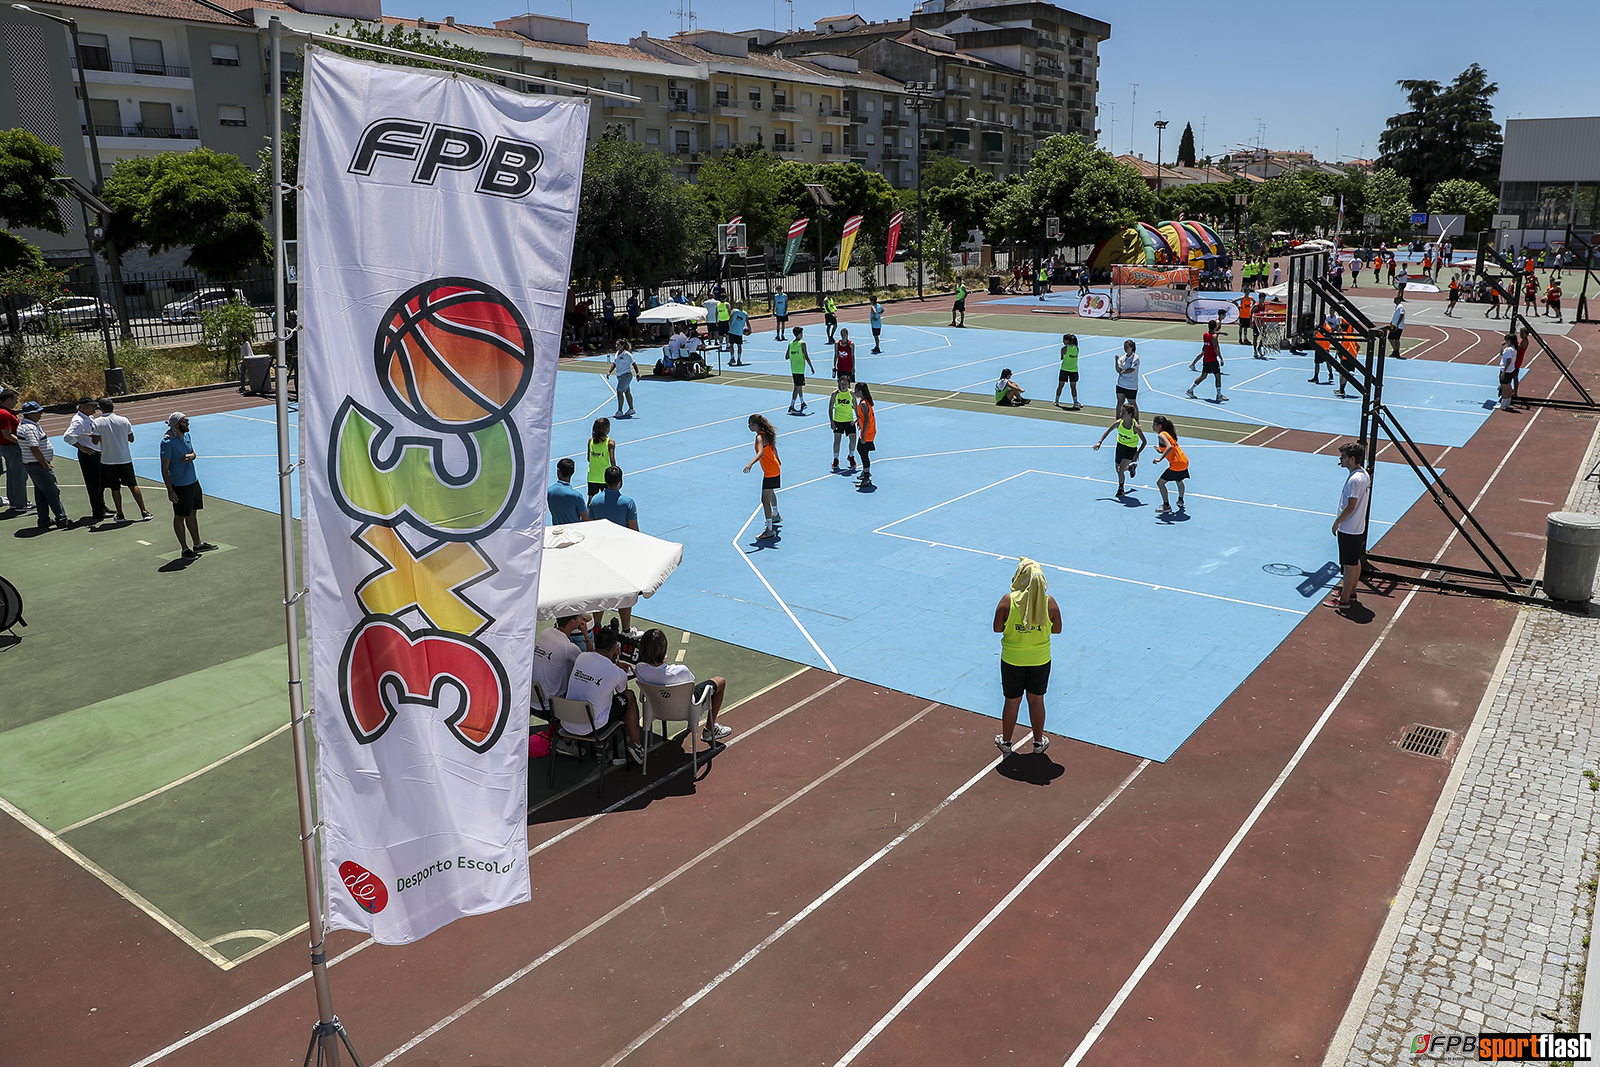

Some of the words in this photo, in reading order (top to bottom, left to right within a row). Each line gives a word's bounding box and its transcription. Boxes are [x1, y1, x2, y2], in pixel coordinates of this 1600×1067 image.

[347, 117, 544, 199] FPB
[396, 859, 453, 893] Desporto
[457, 856, 516, 875] Escolar
